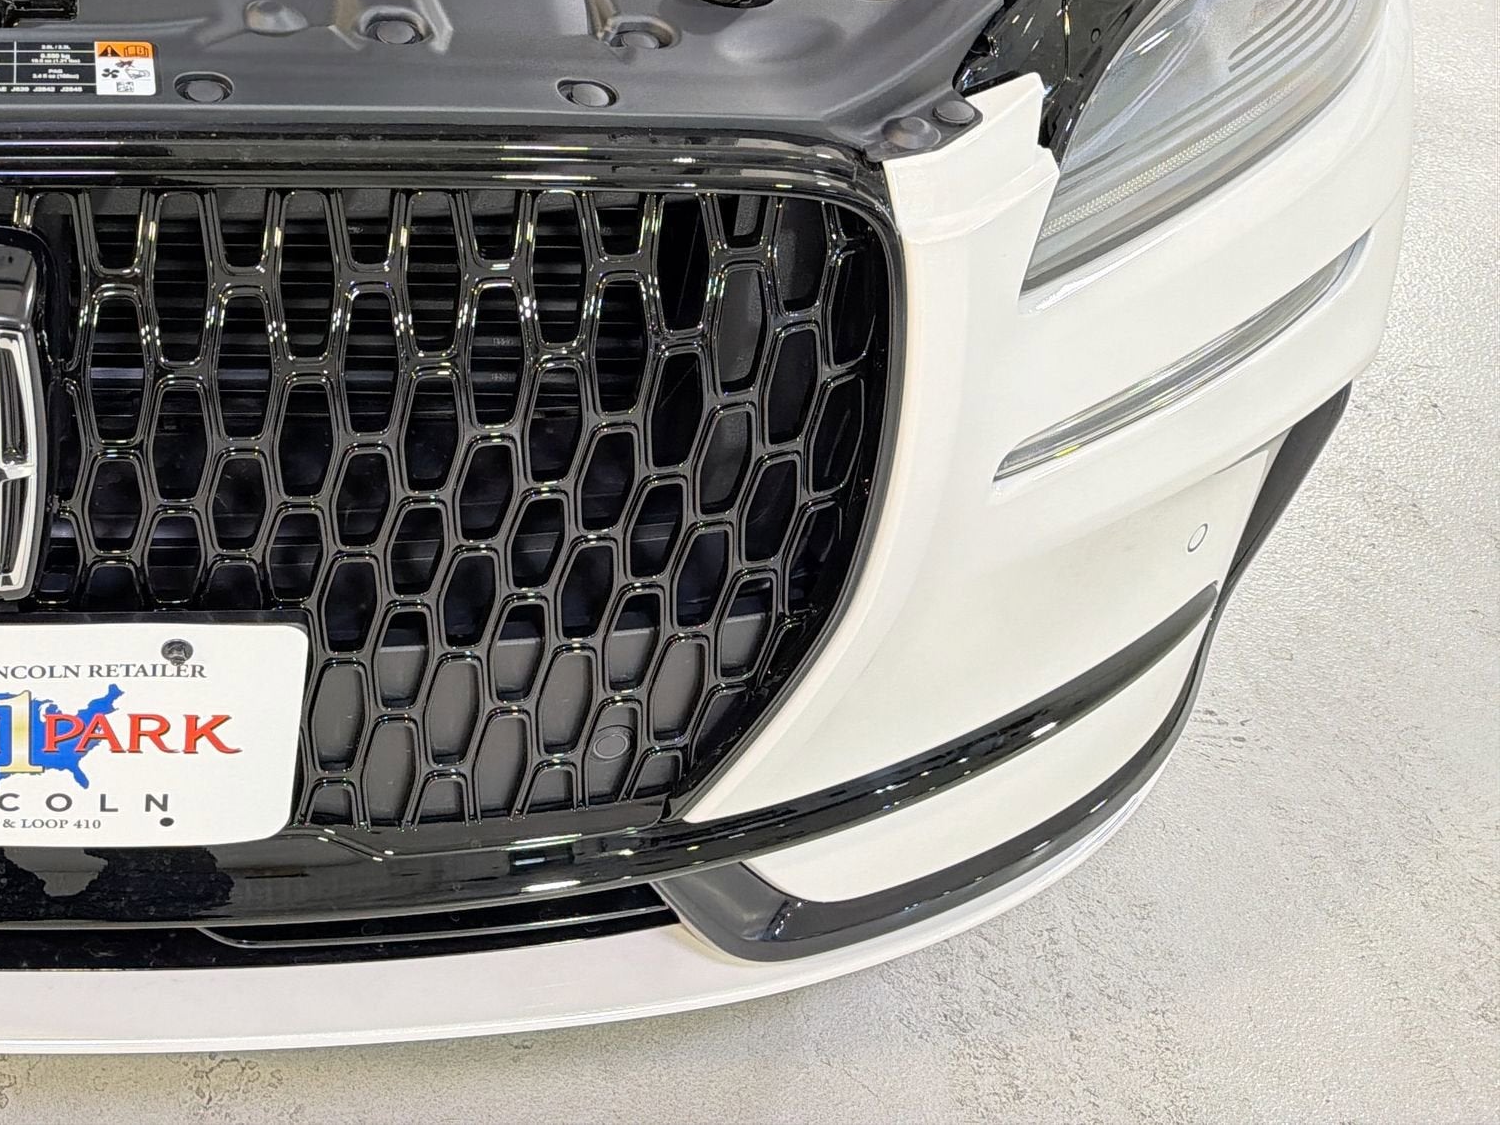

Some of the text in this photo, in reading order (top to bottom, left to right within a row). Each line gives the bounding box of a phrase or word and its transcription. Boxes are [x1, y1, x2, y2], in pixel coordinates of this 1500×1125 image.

[88, 663, 208, 679] RETAILER
[42, 712, 244, 755] PARK
[2, 818, 16, 829] &
[21, 818, 69, 830] LOOP
[73, 818, 102, 830] 410
